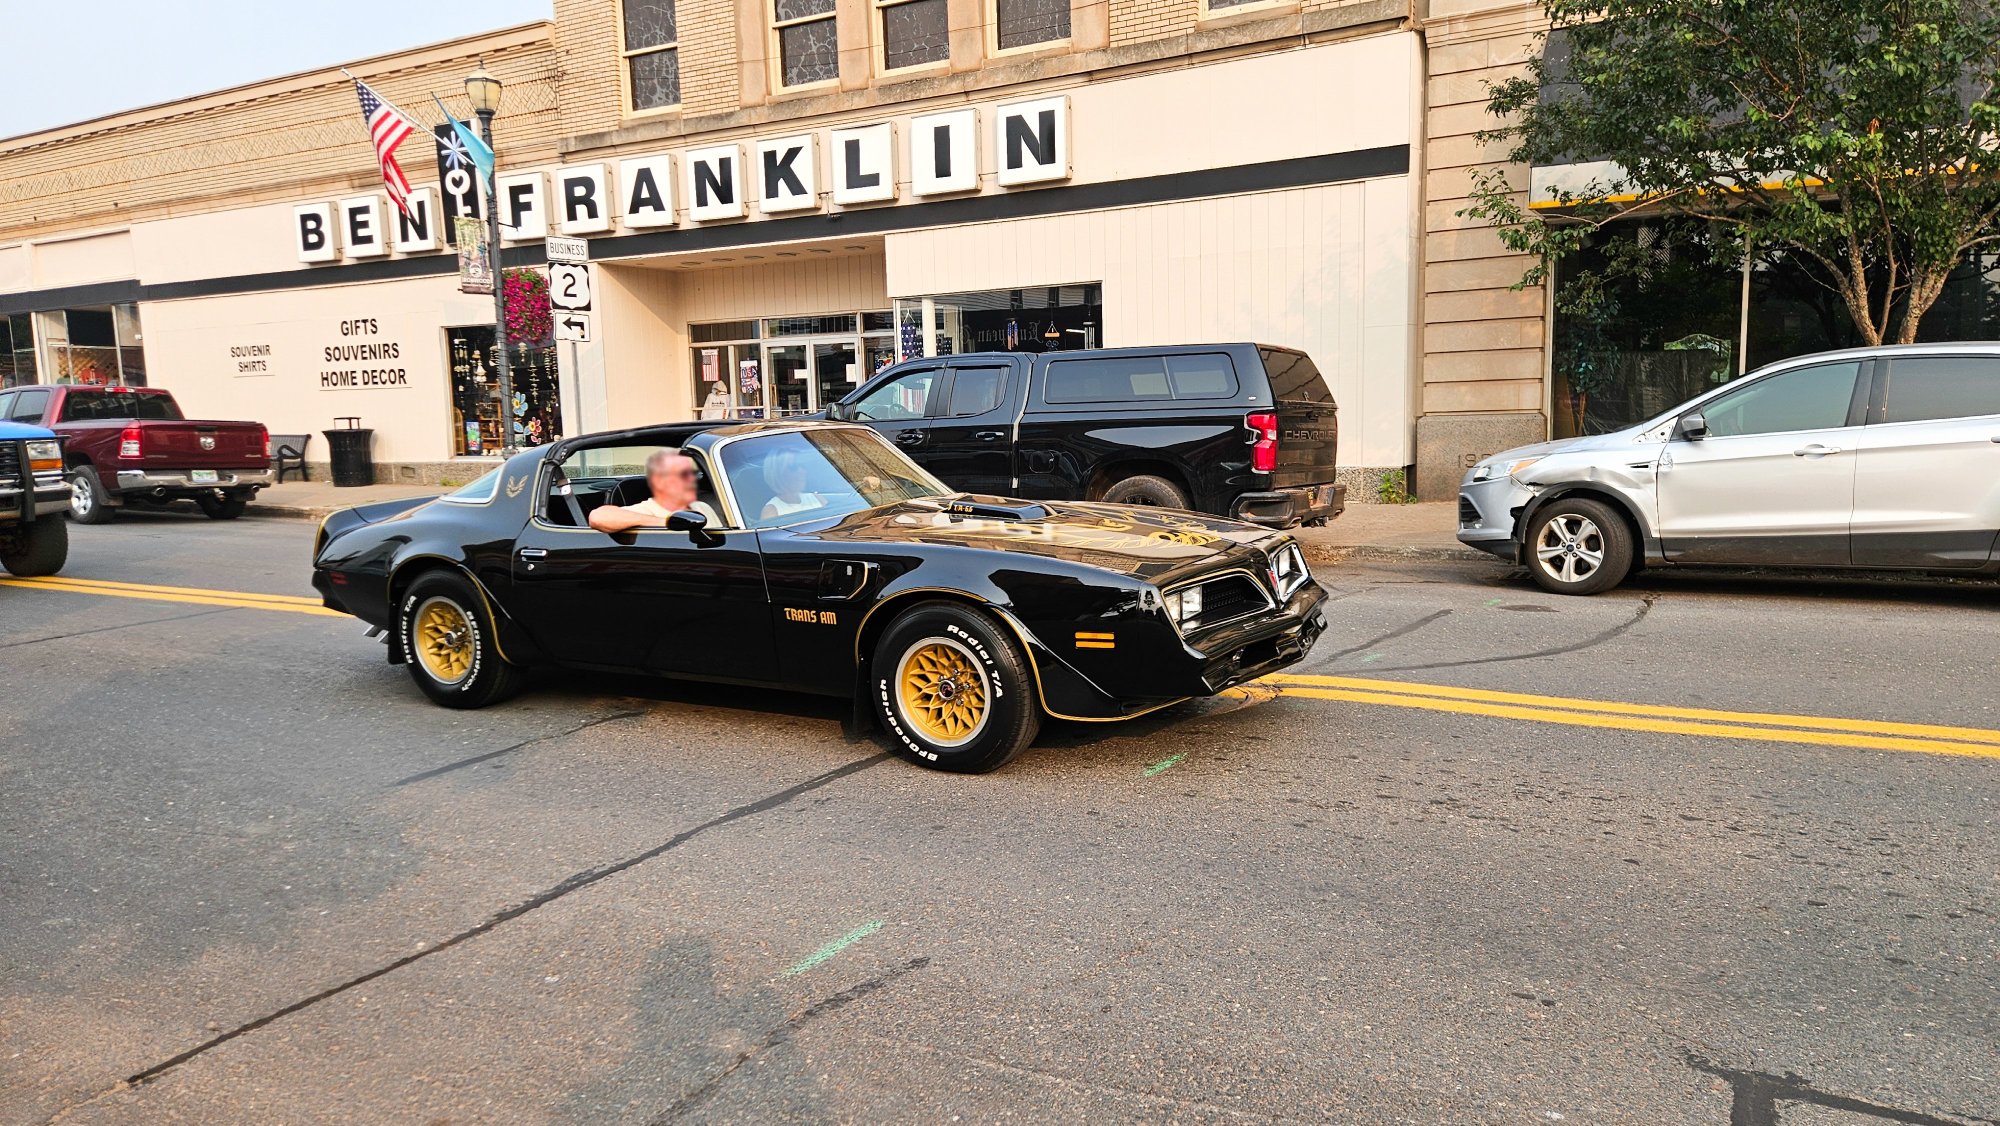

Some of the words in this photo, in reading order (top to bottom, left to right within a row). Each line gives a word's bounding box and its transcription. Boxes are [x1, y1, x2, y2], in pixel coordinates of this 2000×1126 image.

[299, 201, 429, 252] BEN
[508, 109, 1057, 228] FRANKLIN
[550, 243, 585, 256] BUSINESS
[562, 273, 578, 297] 2
[340, 318, 378, 336] GIFTS
[230, 344, 271, 358] SOUVENIR
[324, 342, 400, 362] SOUVENIRS
[238, 360, 267, 372] SHIRTS
[320, 370, 358, 387] HOME
[362, 368, 407, 386] DECOR
[783, 607, 818, 623] TRANS
[820, 611, 837, 625] AM
[946, 624, 994, 666] Radial
[990, 669, 1004, 698] T/A
[879, 678, 939, 762] BFGoodrich
